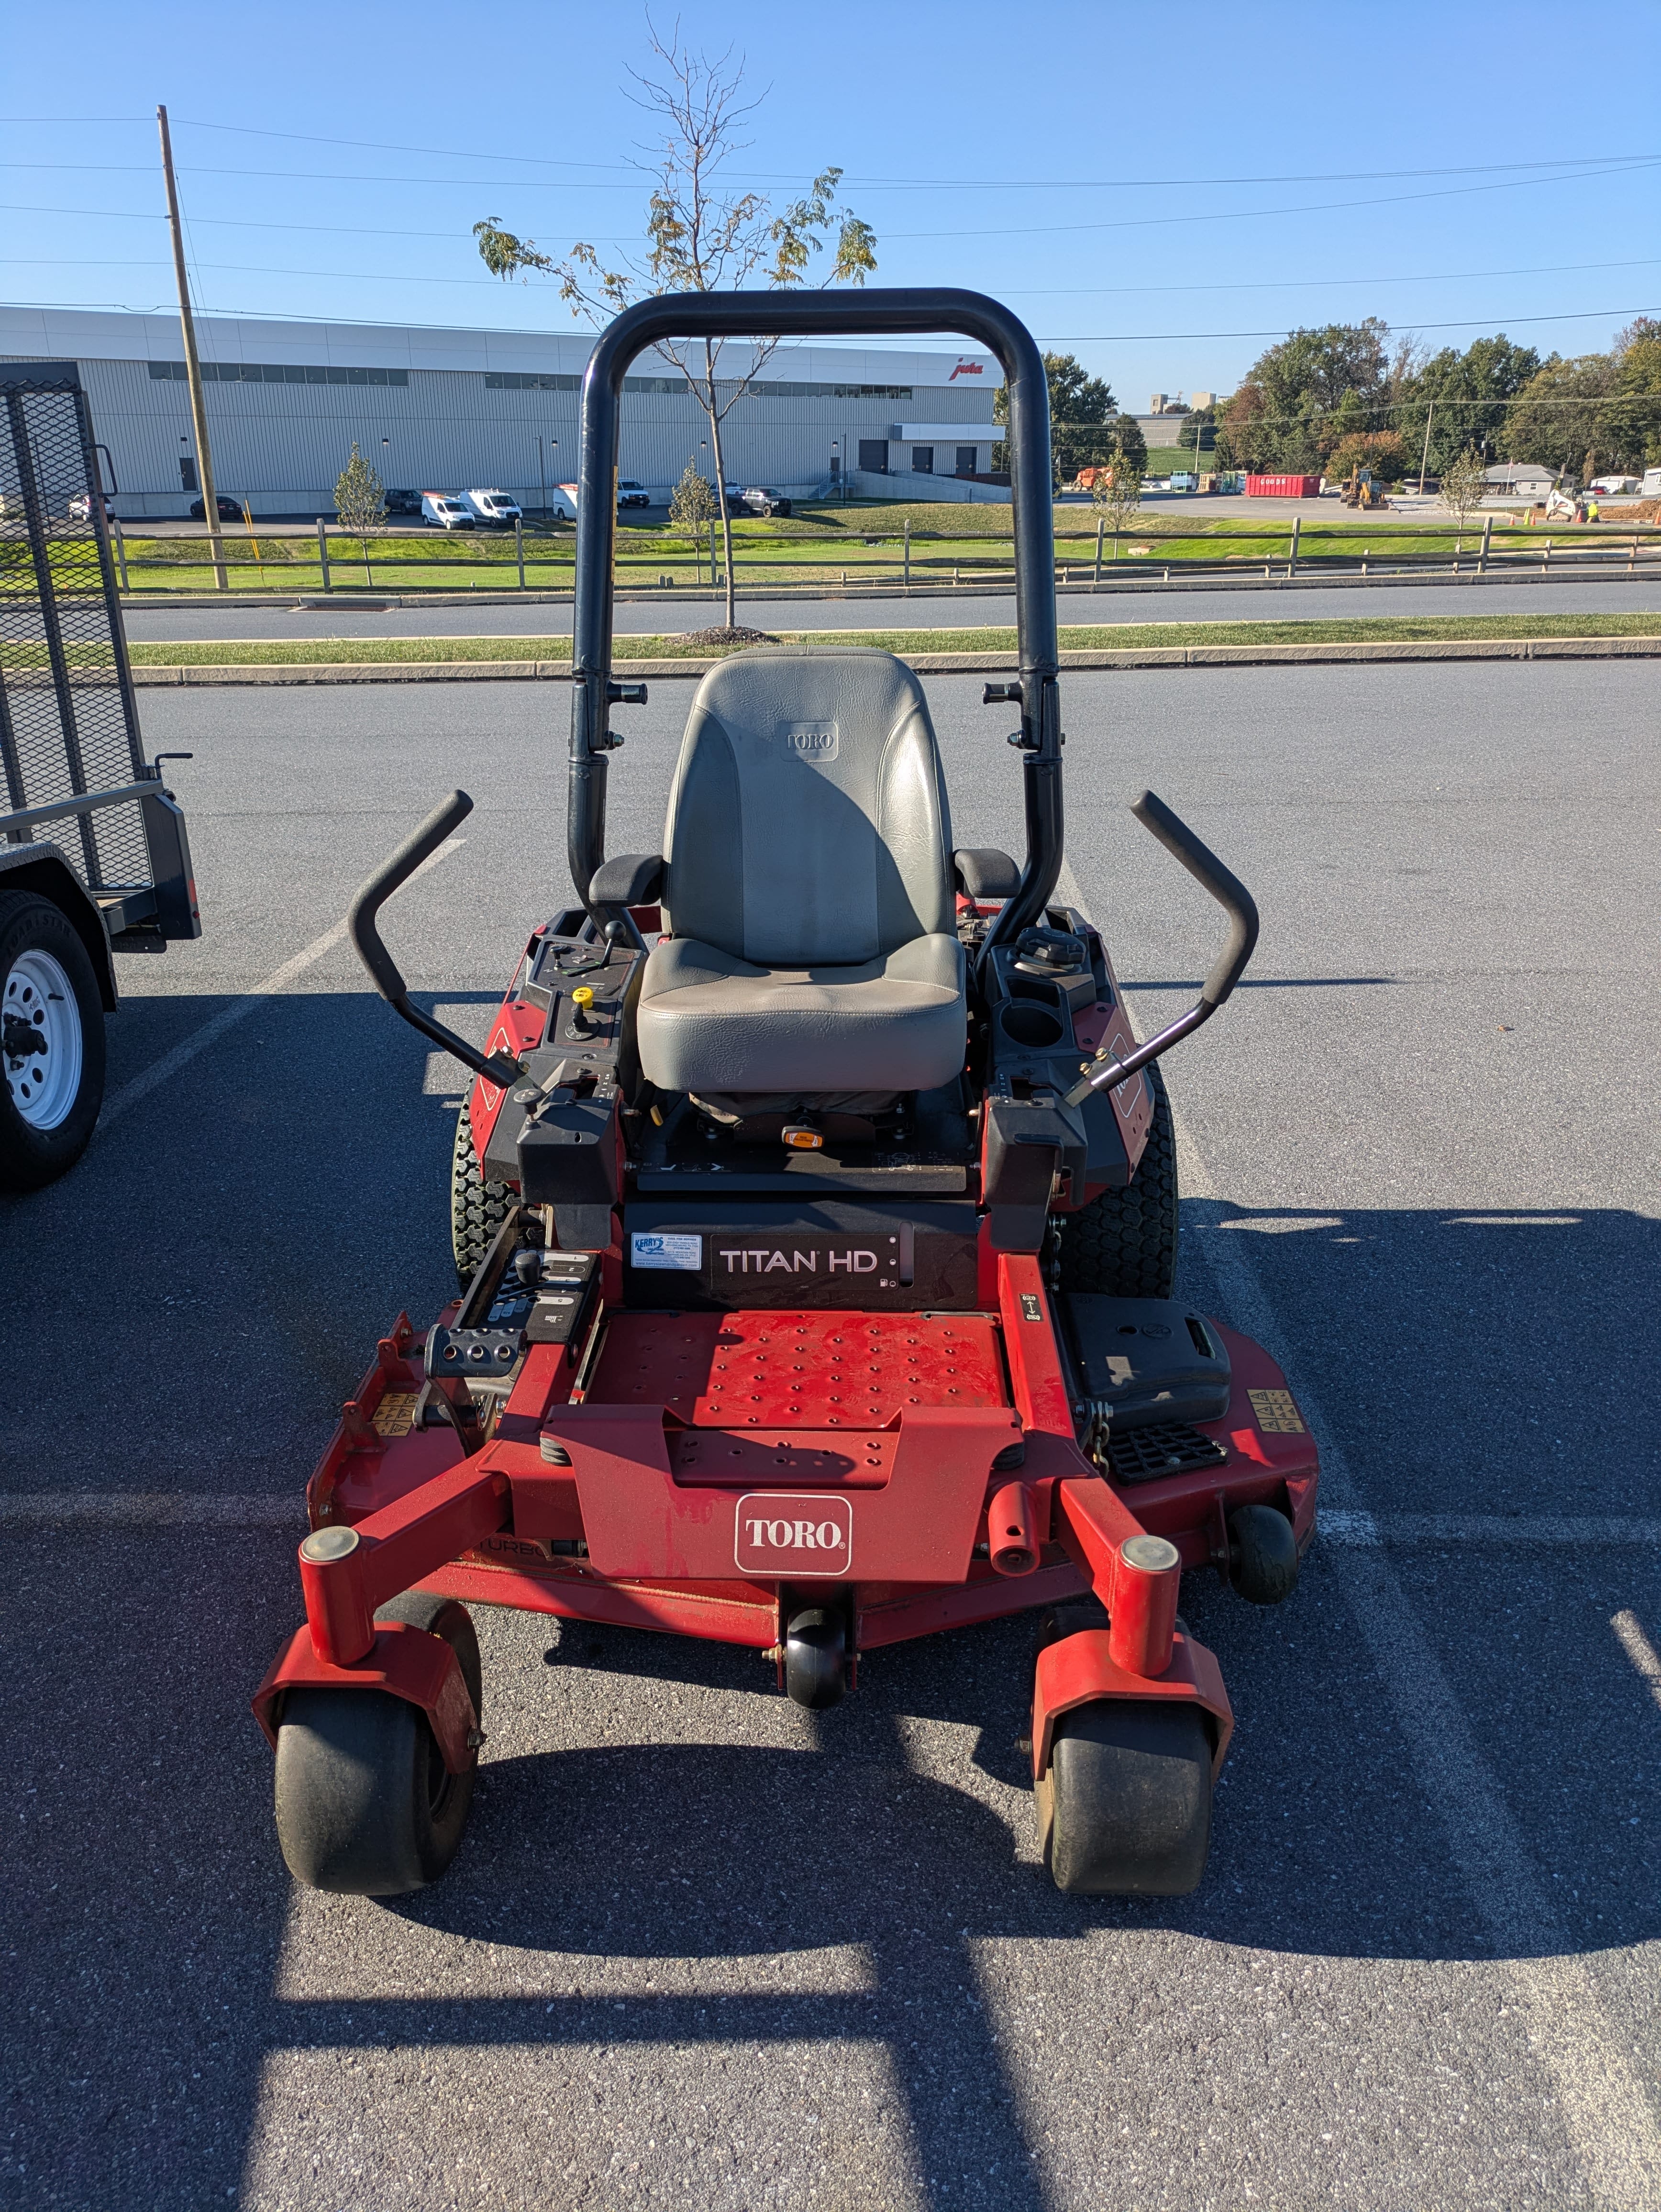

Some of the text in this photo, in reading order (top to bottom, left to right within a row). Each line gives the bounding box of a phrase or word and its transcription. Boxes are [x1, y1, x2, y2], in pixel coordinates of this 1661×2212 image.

[784, 734, 834, 750] TORO
[635, 1237, 664, 1248] KERRY'S
[720, 1250, 878, 1272] TITAN HD
[745, 1519, 842, 1549] TORO
